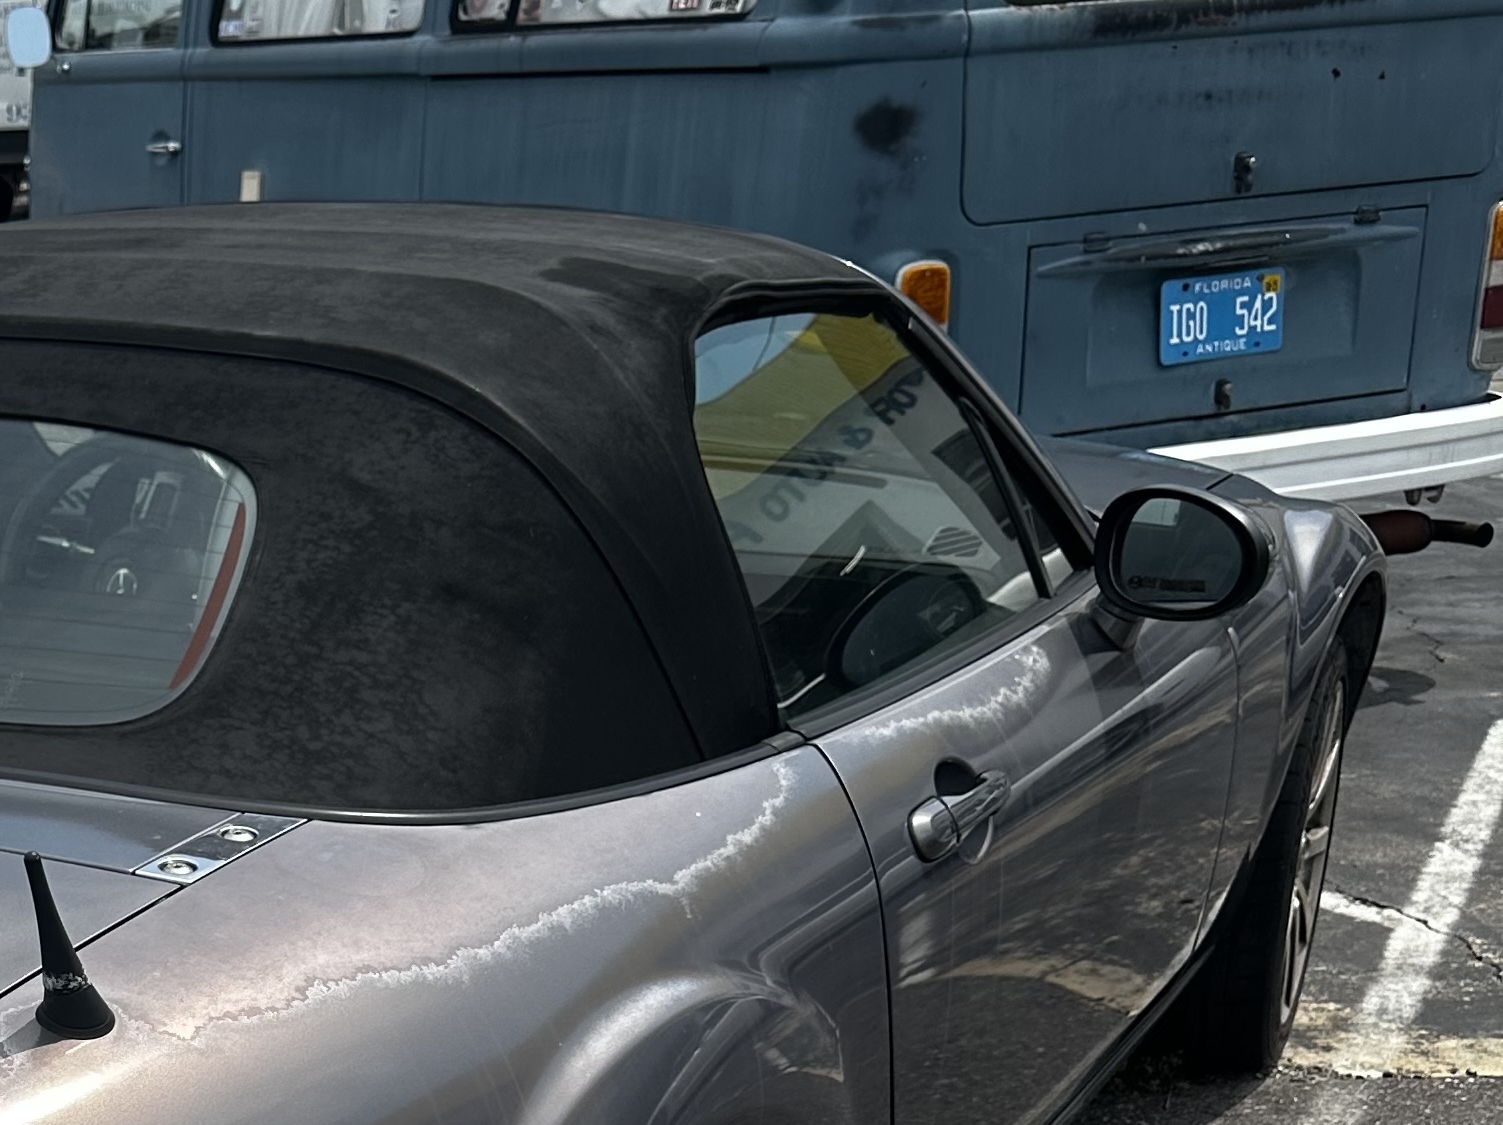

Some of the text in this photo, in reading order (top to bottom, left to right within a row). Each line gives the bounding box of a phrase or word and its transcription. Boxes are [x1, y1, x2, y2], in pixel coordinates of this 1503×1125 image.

[1194, 276, 1252, 294] FLORIDA
[1235, 291, 1278, 336] 542
[1196, 338, 1247, 355] ANTIQUE
